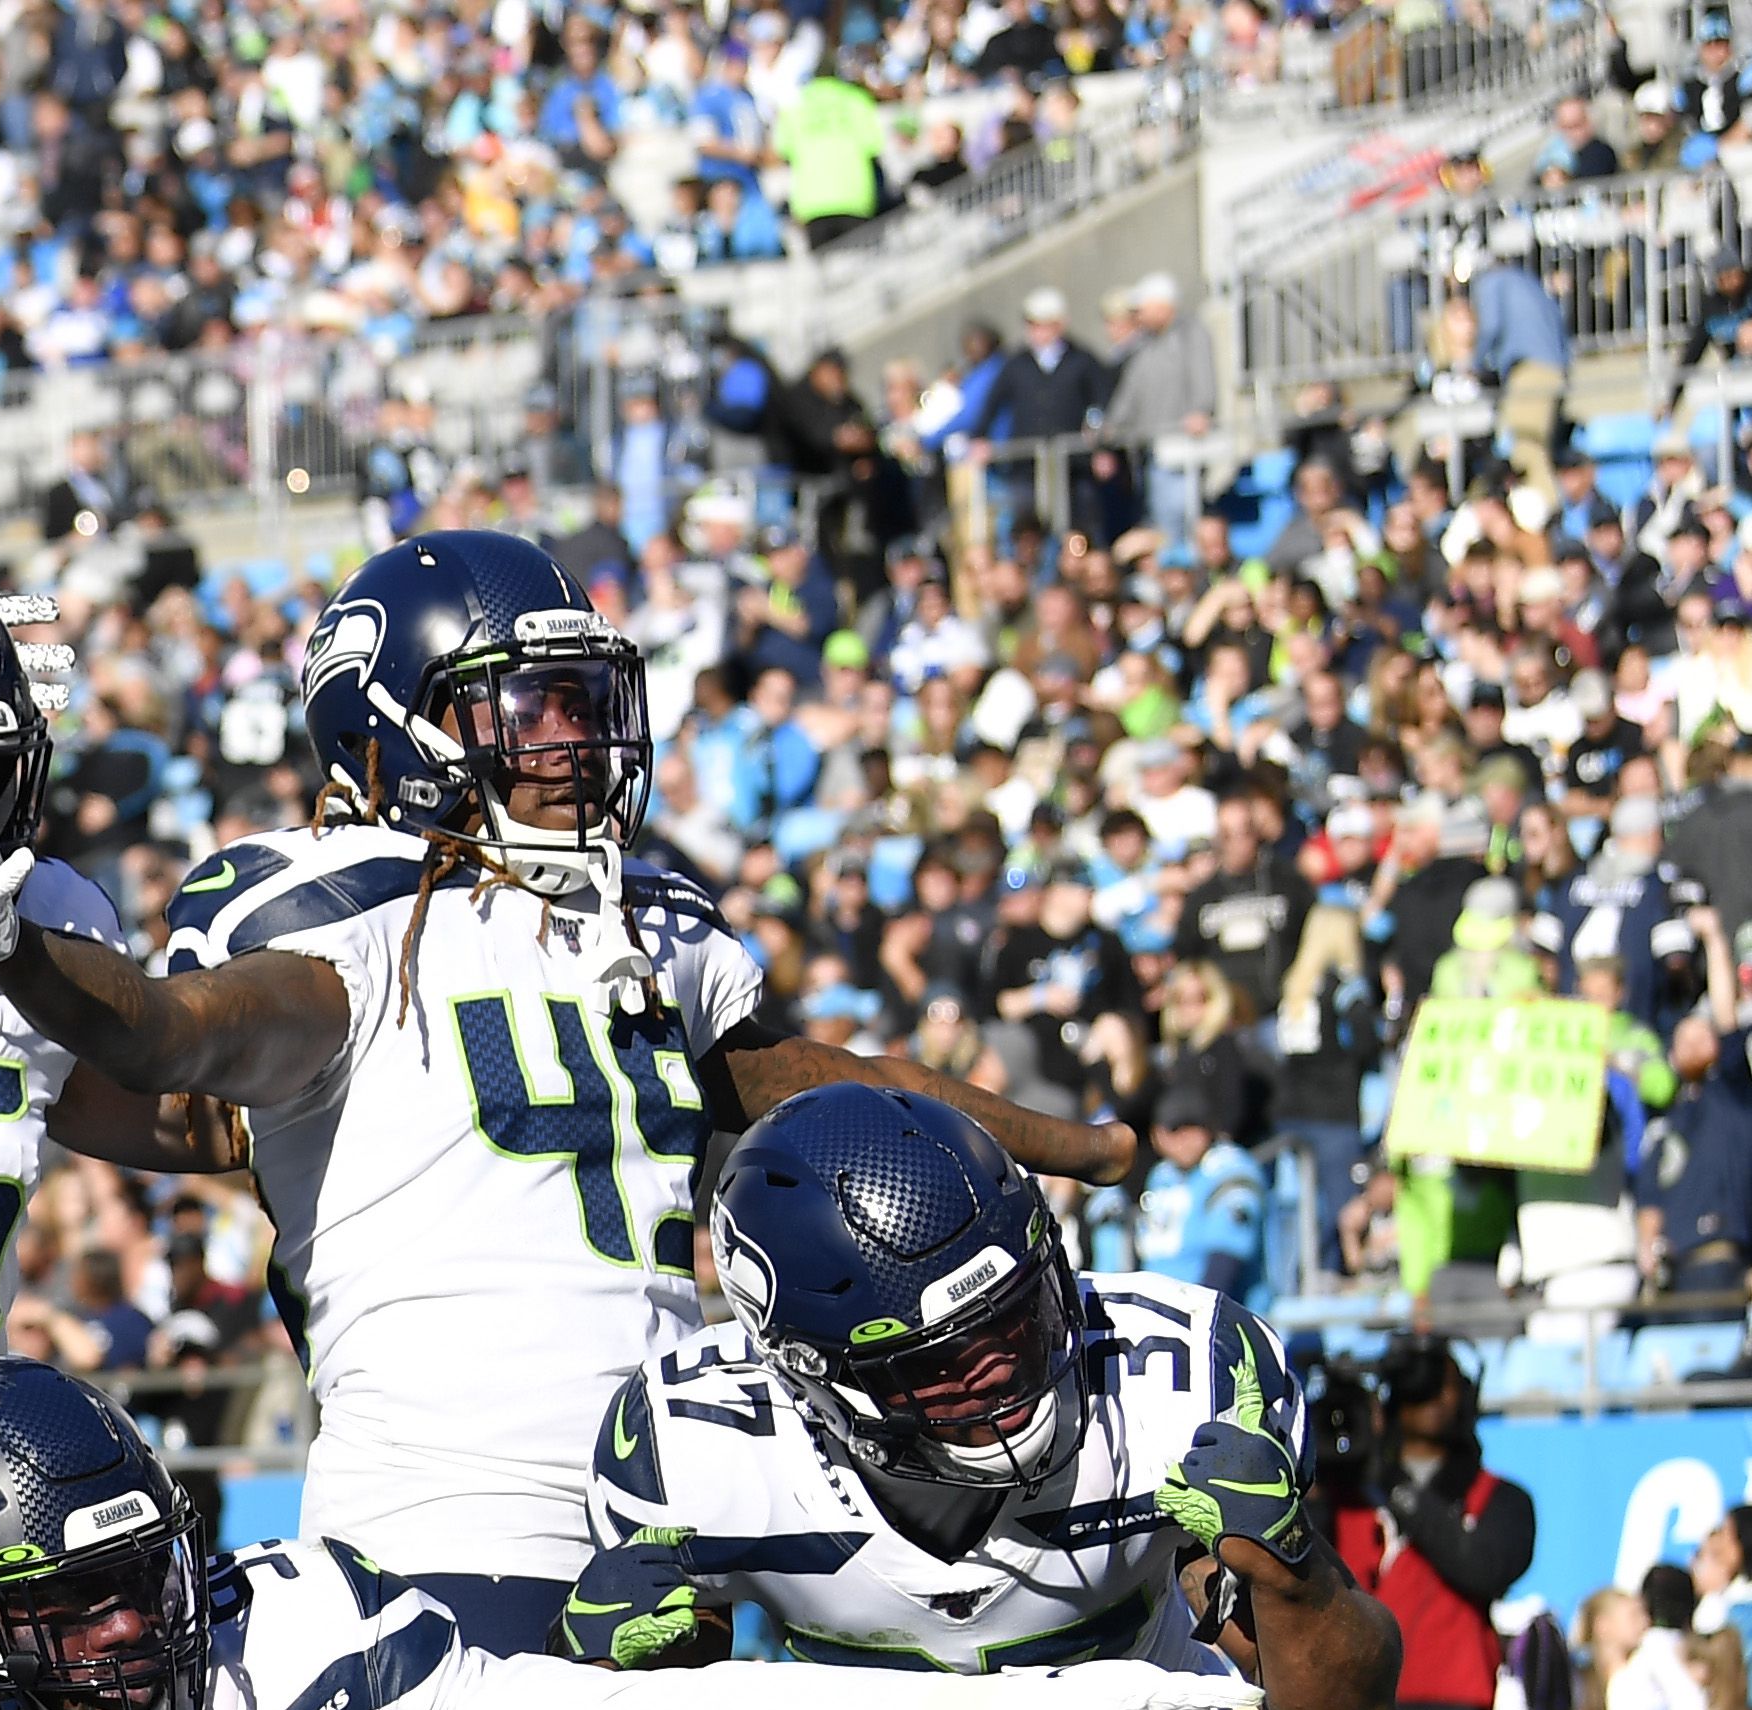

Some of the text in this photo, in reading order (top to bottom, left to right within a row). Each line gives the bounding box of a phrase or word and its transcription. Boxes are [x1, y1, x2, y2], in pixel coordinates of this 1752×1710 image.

[447, 988, 713, 1281] 49
[947, 1259, 997, 1302] SEAHAWKS
[660, 1334, 777, 1437] 37
[1084, 1291, 1192, 1396] 37
[93, 1497, 143, 1529] SEAHAWKS
